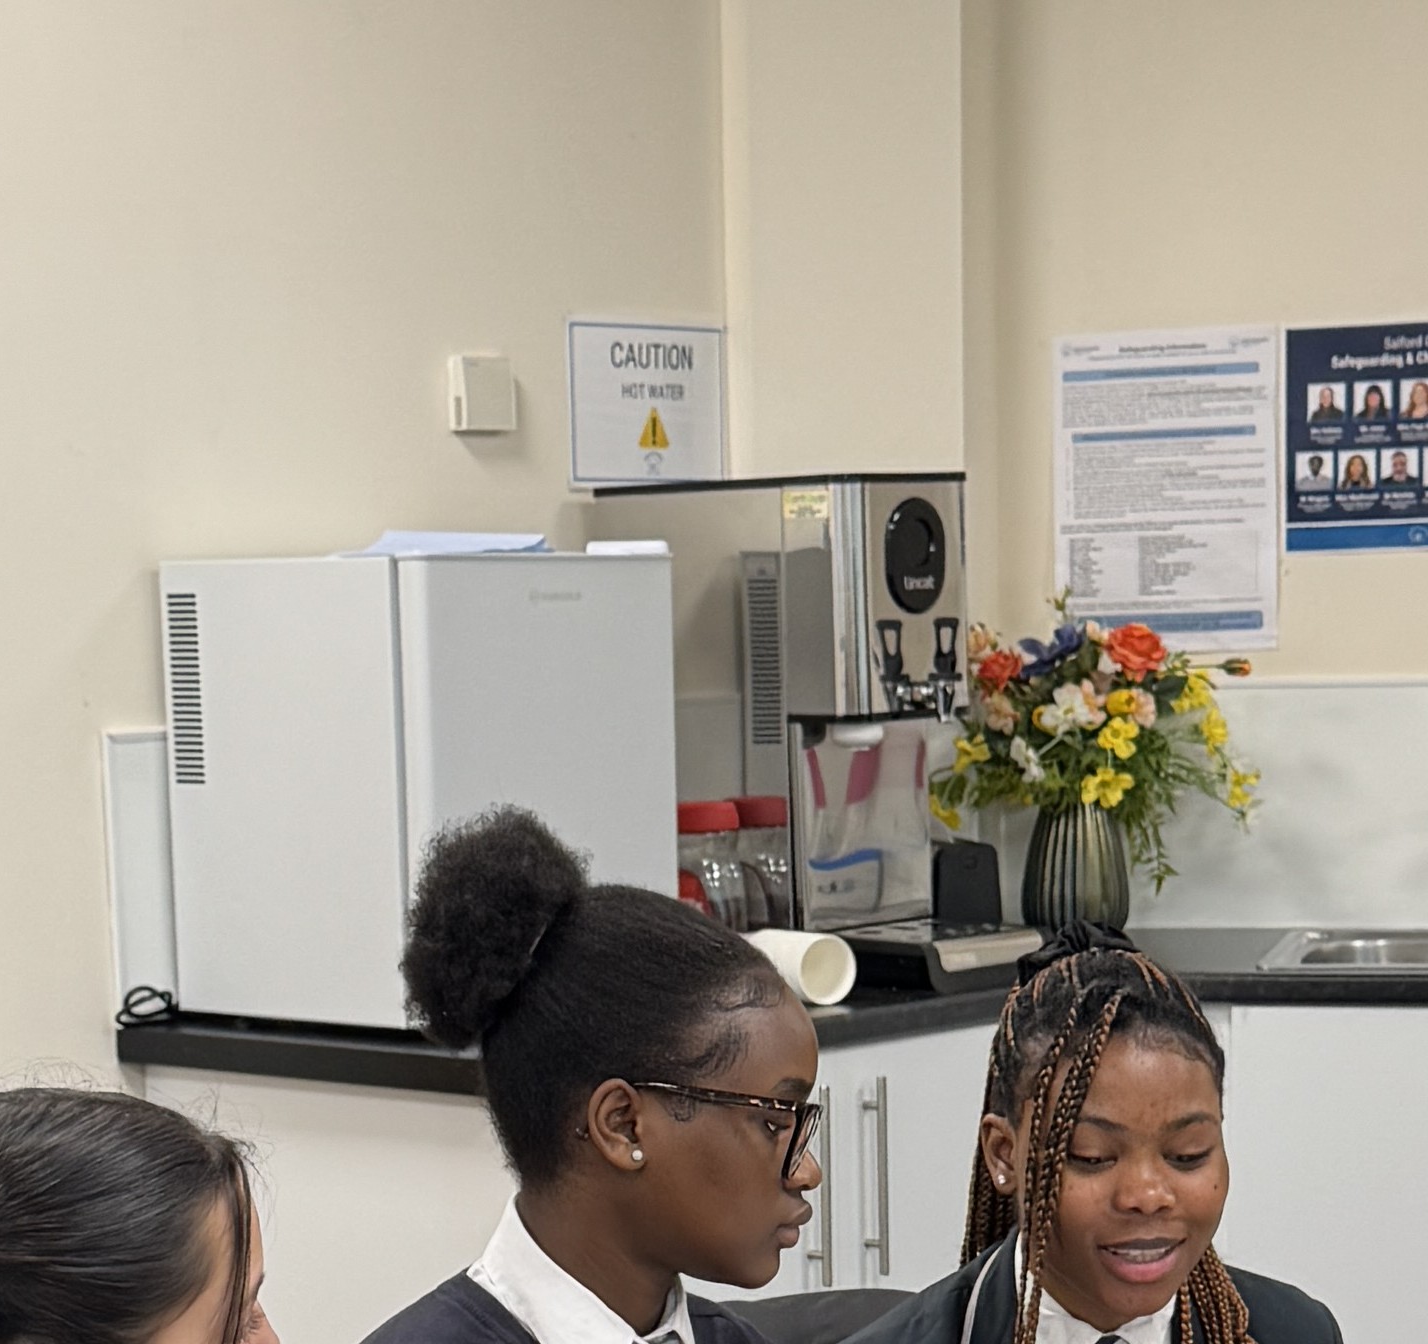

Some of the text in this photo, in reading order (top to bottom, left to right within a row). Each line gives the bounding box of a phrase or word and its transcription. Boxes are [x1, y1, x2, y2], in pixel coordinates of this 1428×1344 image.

[1384, 335, 1422, 350] Salford
[610, 341, 694, 371] CAUTION
[1331, 353, 1405, 370] Safeguarding
[1406, 353, 1414, 365] &
[621, 382, 685, 402] HOT WATER
